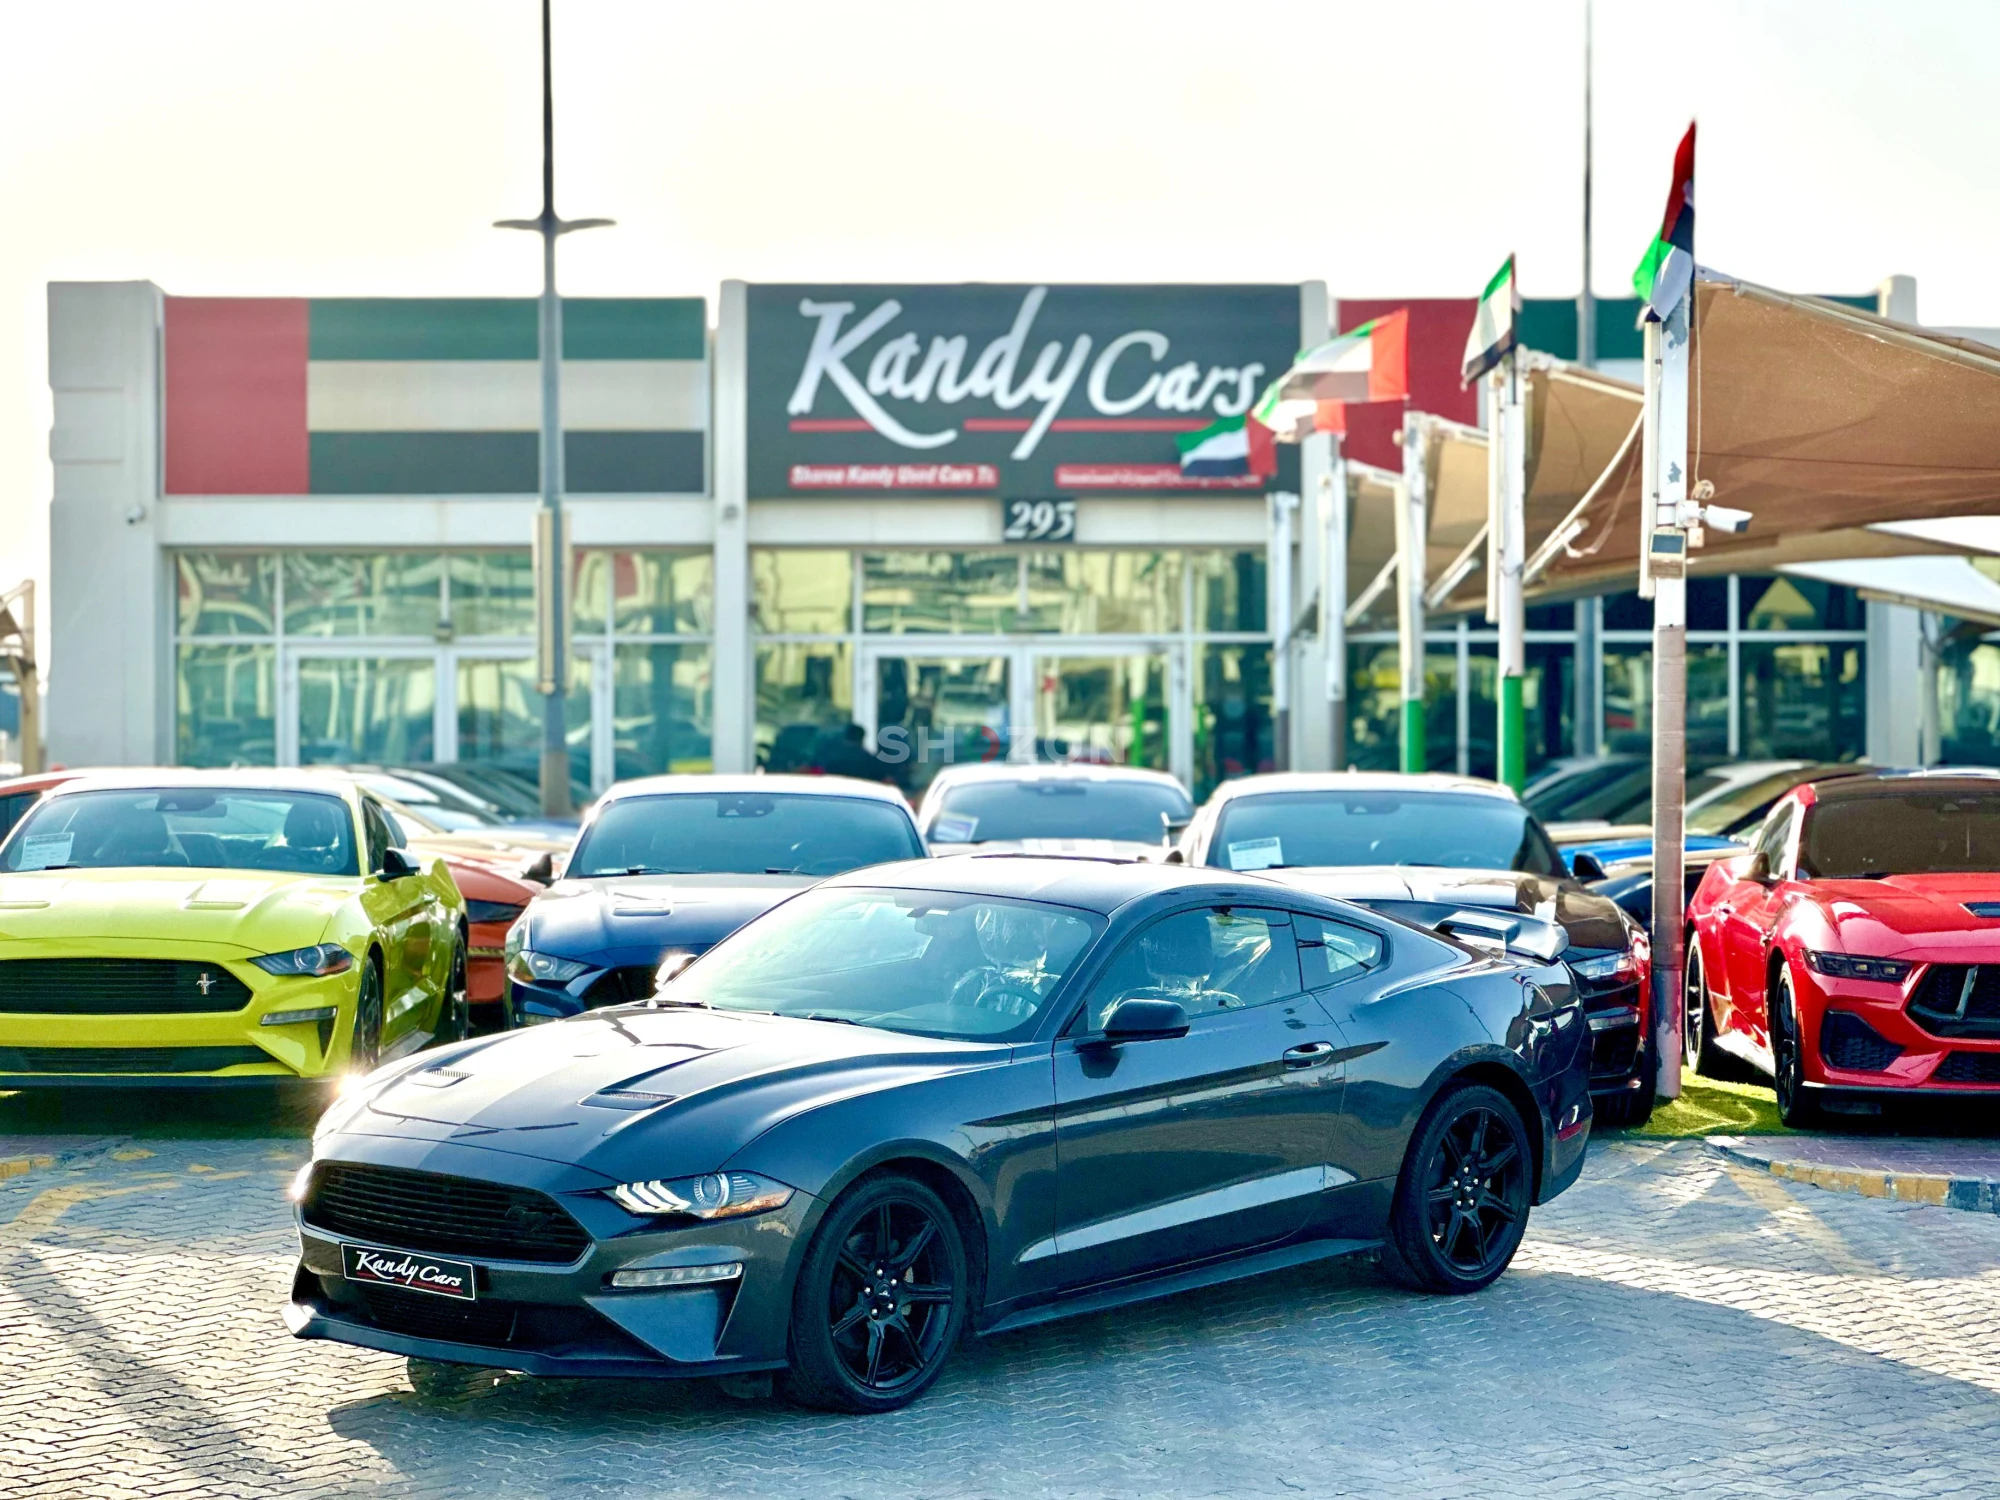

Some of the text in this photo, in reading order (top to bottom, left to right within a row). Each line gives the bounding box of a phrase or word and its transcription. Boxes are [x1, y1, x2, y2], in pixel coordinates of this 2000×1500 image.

[788, 286, 1265, 459] Kandy Cars
[938, 465, 974, 485] Cars
[1004, 501, 1076, 540] 295
[356, 1251, 462, 1286] Kandy Cars
